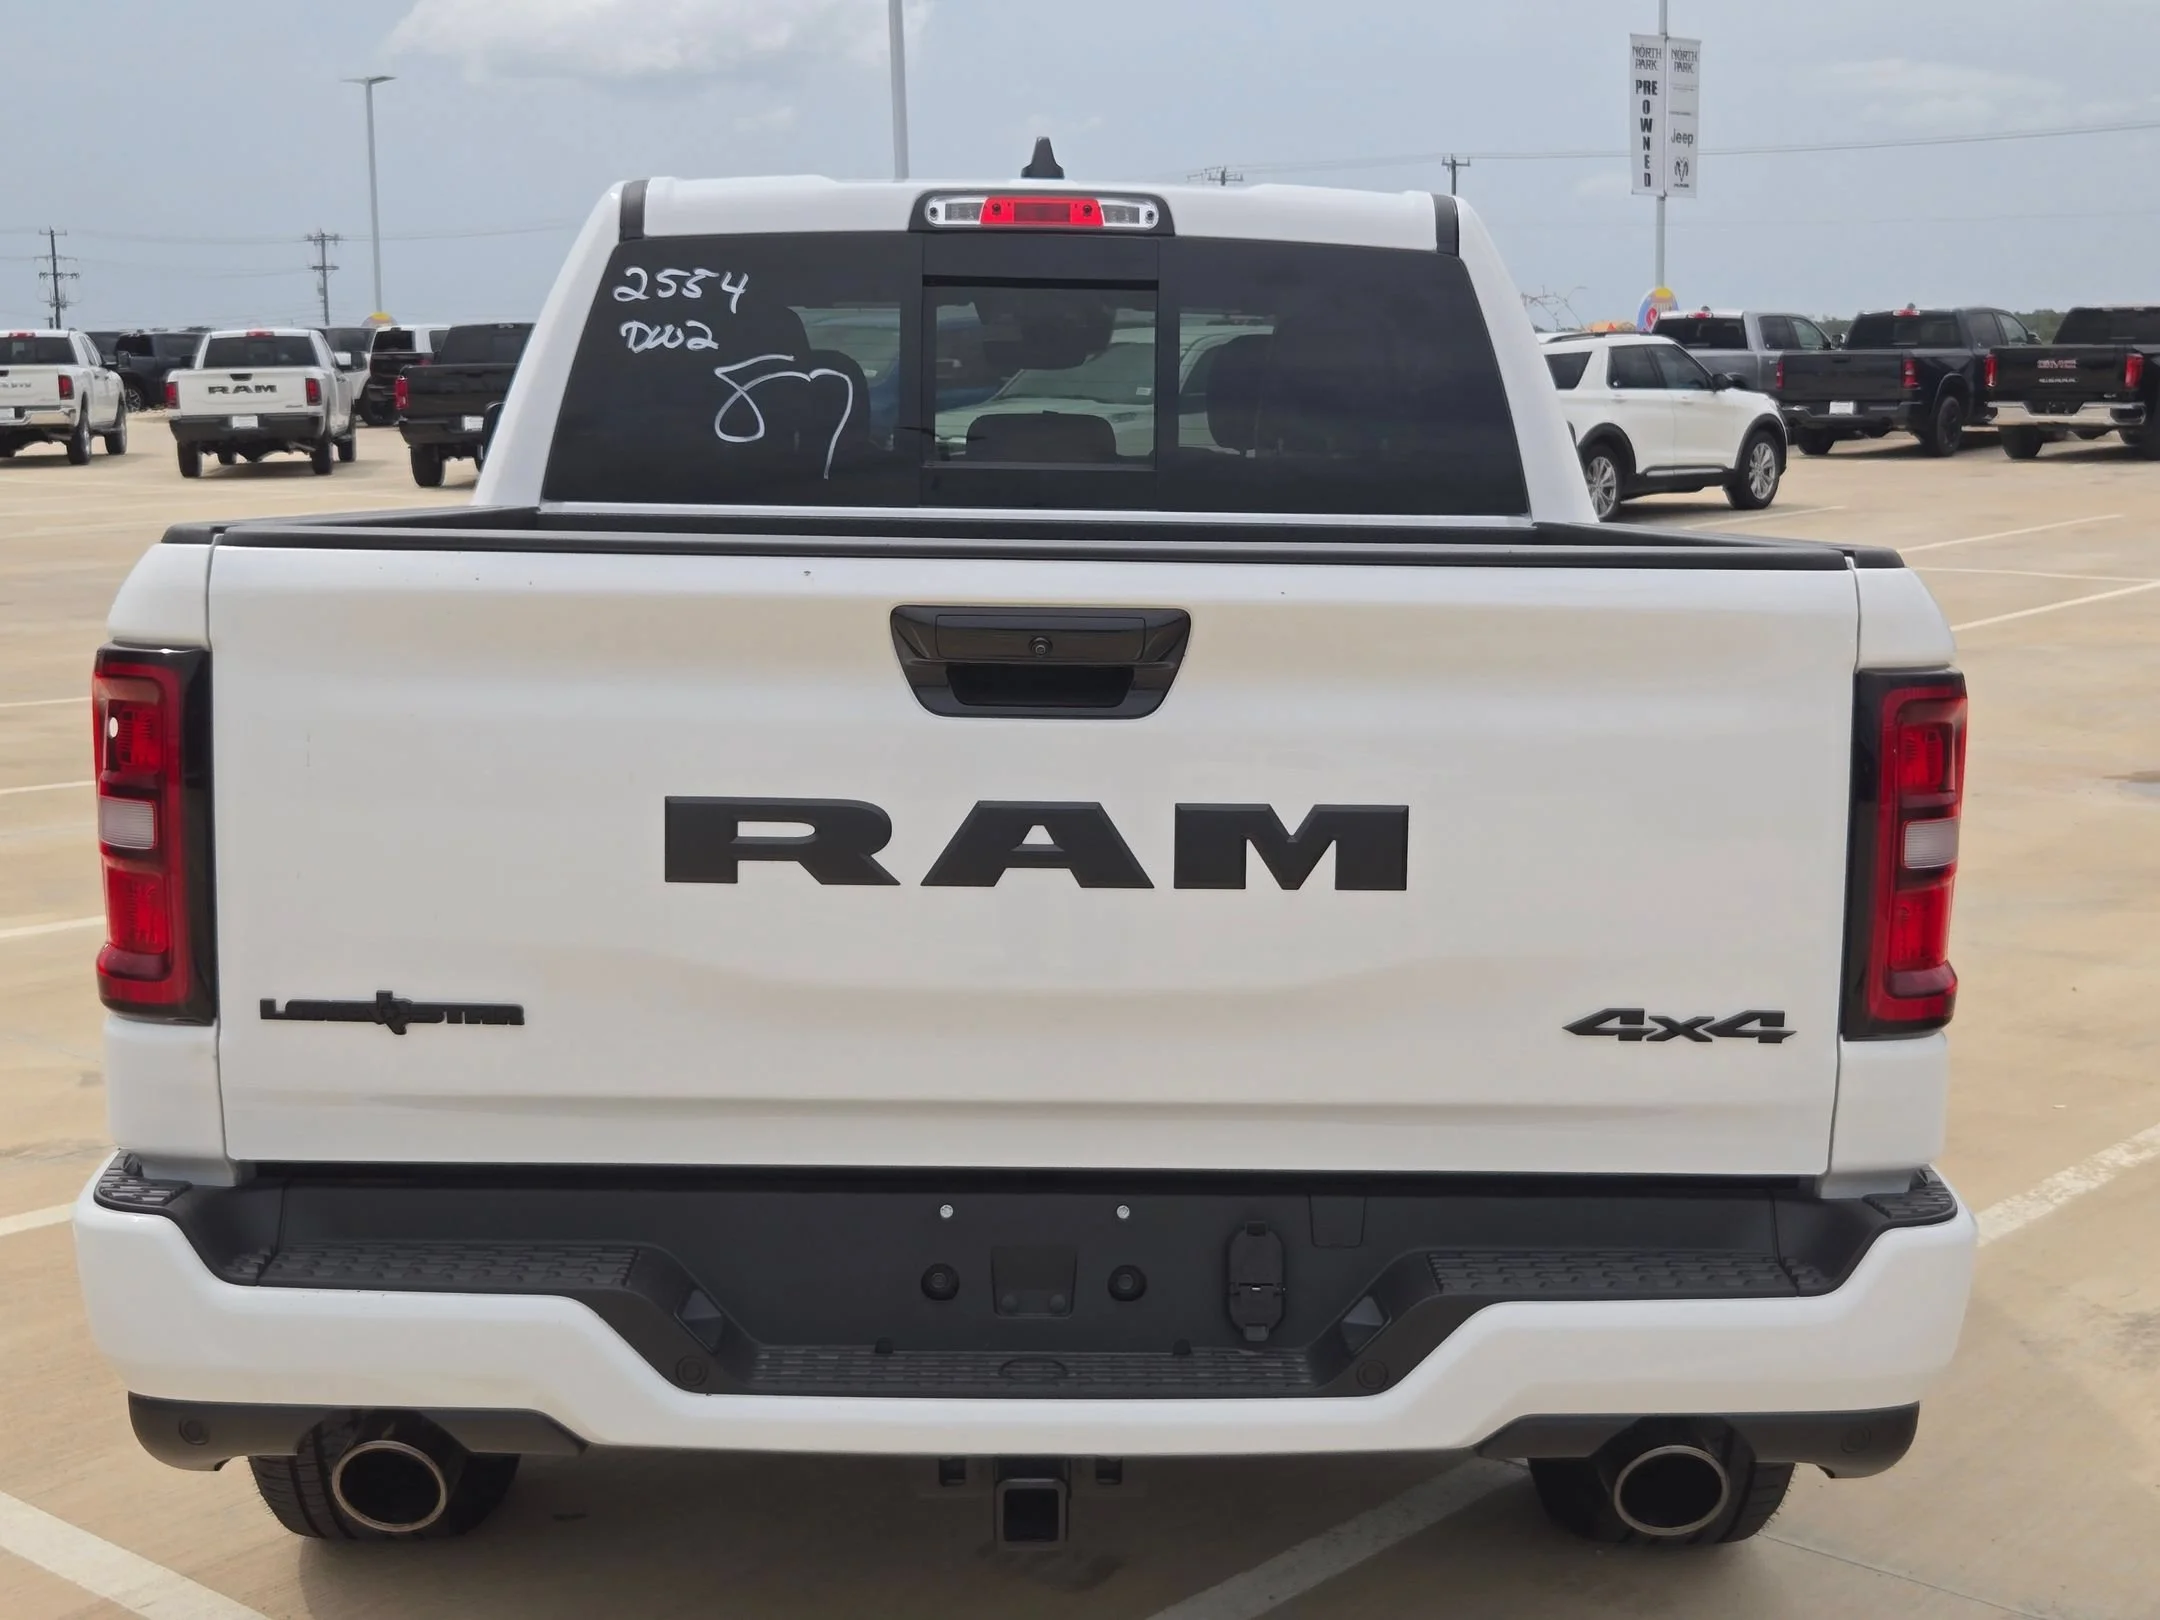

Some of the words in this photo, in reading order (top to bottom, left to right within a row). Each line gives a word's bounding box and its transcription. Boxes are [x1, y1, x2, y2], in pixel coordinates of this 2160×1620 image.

[1632, 44, 1662, 60] NORTH
[1671, 47, 1698, 62] NORTH
[1635, 58, 1658, 71] PARK
[1674, 61, 1694, 74] PARK
[1636, 79, 1658, 96] PRE
[1671, 128, 1694, 149] Jeep
[613, 266, 749, 314] 2554
[208, 385, 277, 394] RAM
[664, 795, 1409, 891] RAM
[1562, 1007, 1797, 1044] 4x4
